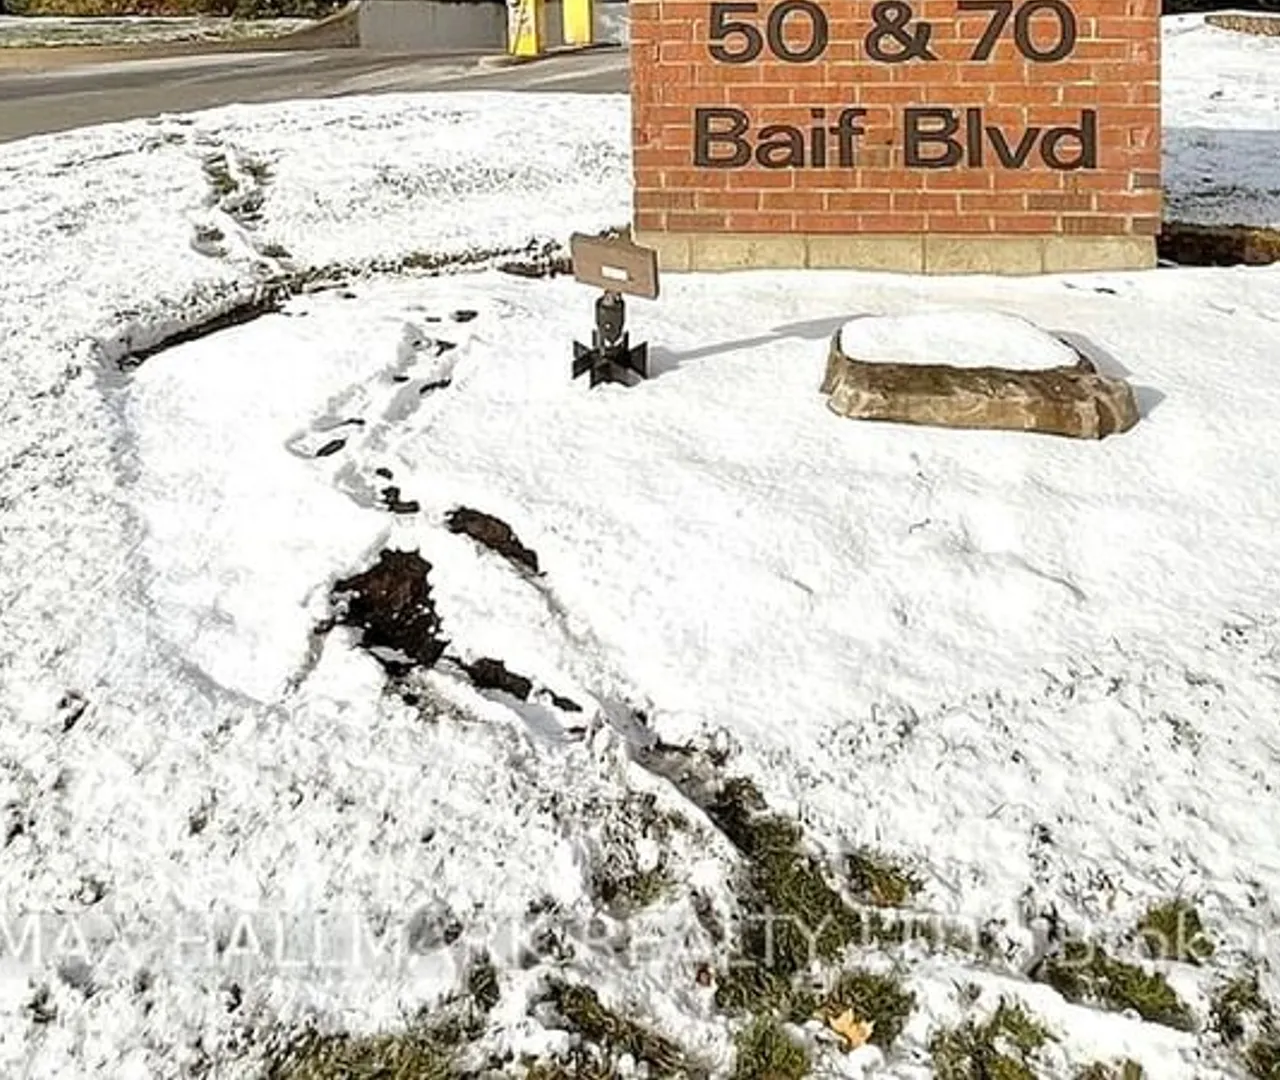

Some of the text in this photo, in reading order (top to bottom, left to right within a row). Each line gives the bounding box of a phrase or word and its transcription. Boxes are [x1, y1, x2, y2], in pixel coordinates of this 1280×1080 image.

[864, 0, 938, 63] &
[693, 107, 1097, 170] Baif Blvd
